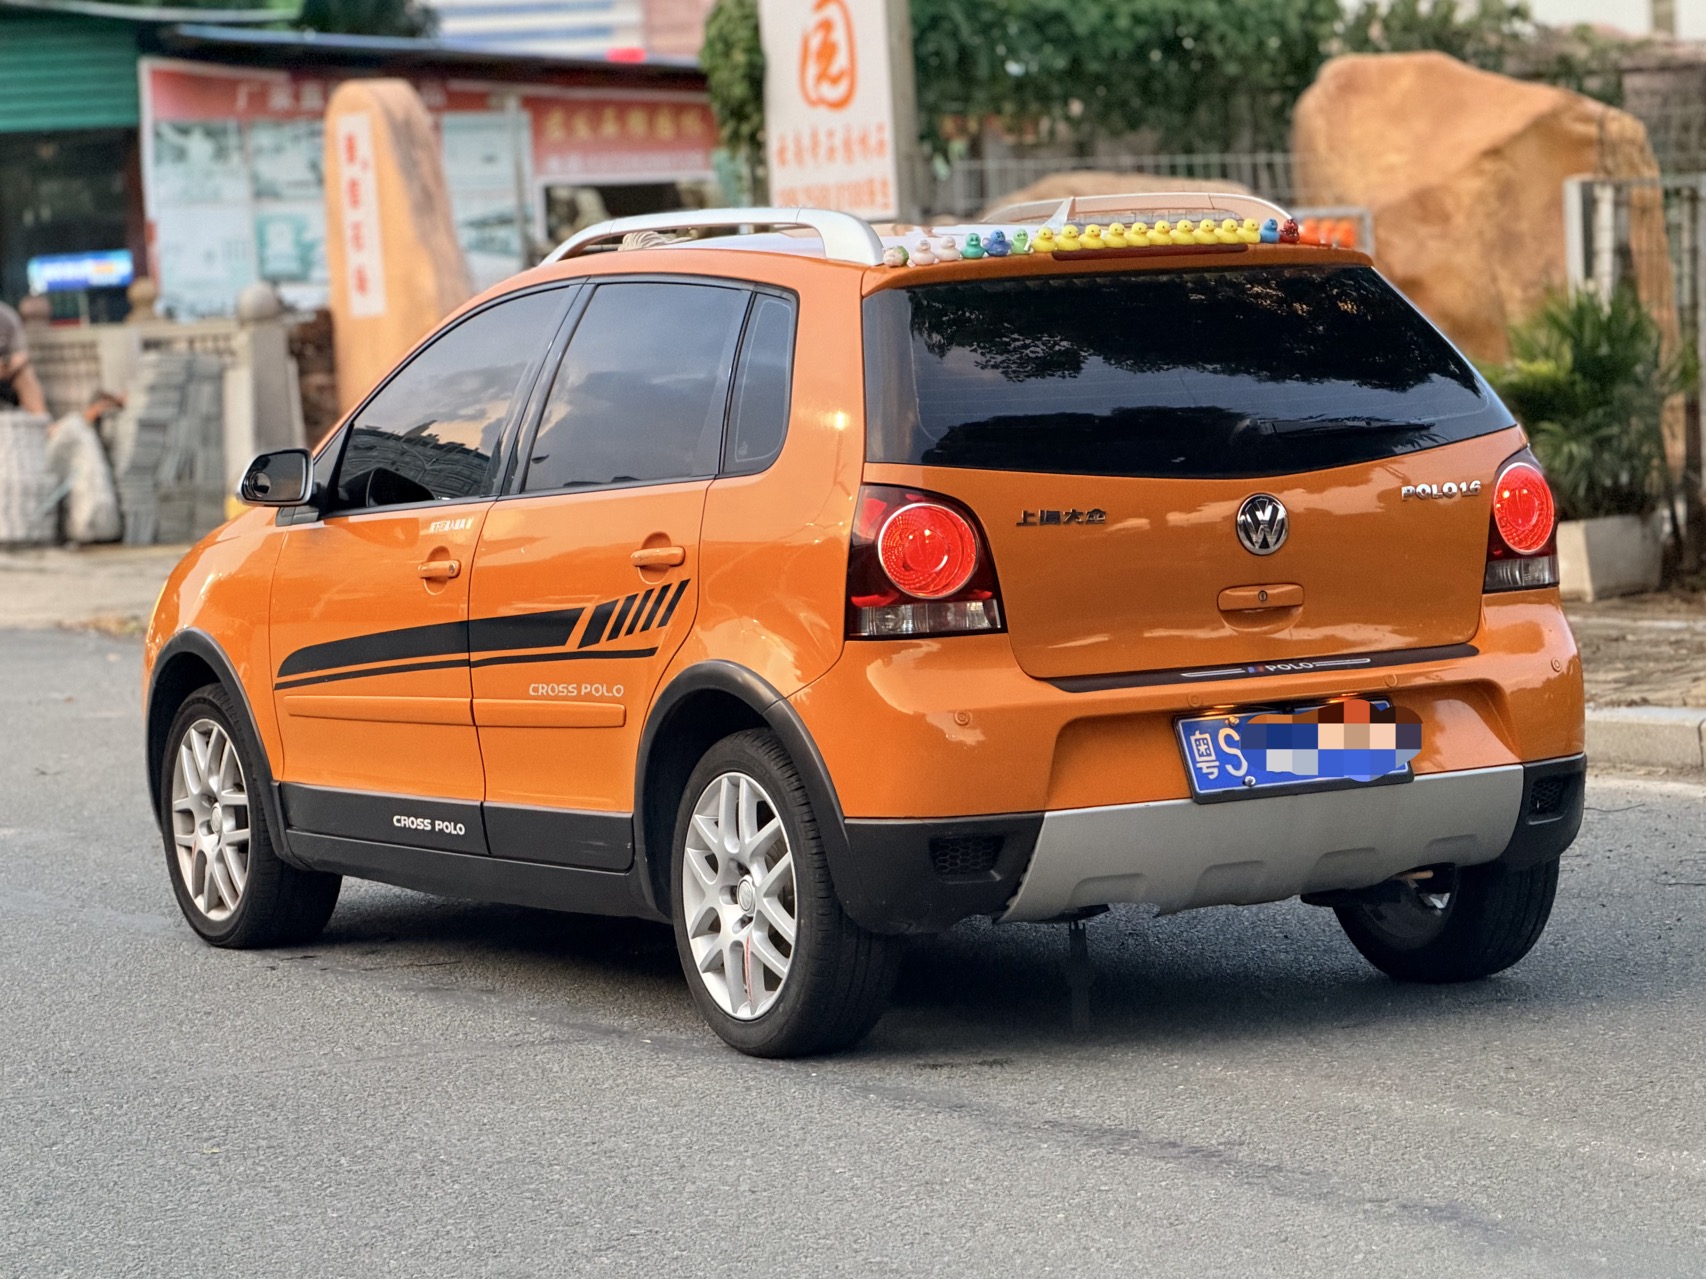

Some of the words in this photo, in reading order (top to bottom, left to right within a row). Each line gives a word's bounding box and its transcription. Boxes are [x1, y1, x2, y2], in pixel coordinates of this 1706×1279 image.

[1402, 482, 1458, 501] POLO
[1265, 662, 1314, 672] POLO
[529, 683, 577, 696] CROSS
[581, 683, 624, 697] POLO
[392, 815, 432, 831] CROSS
[434, 820, 466, 836] POLO
